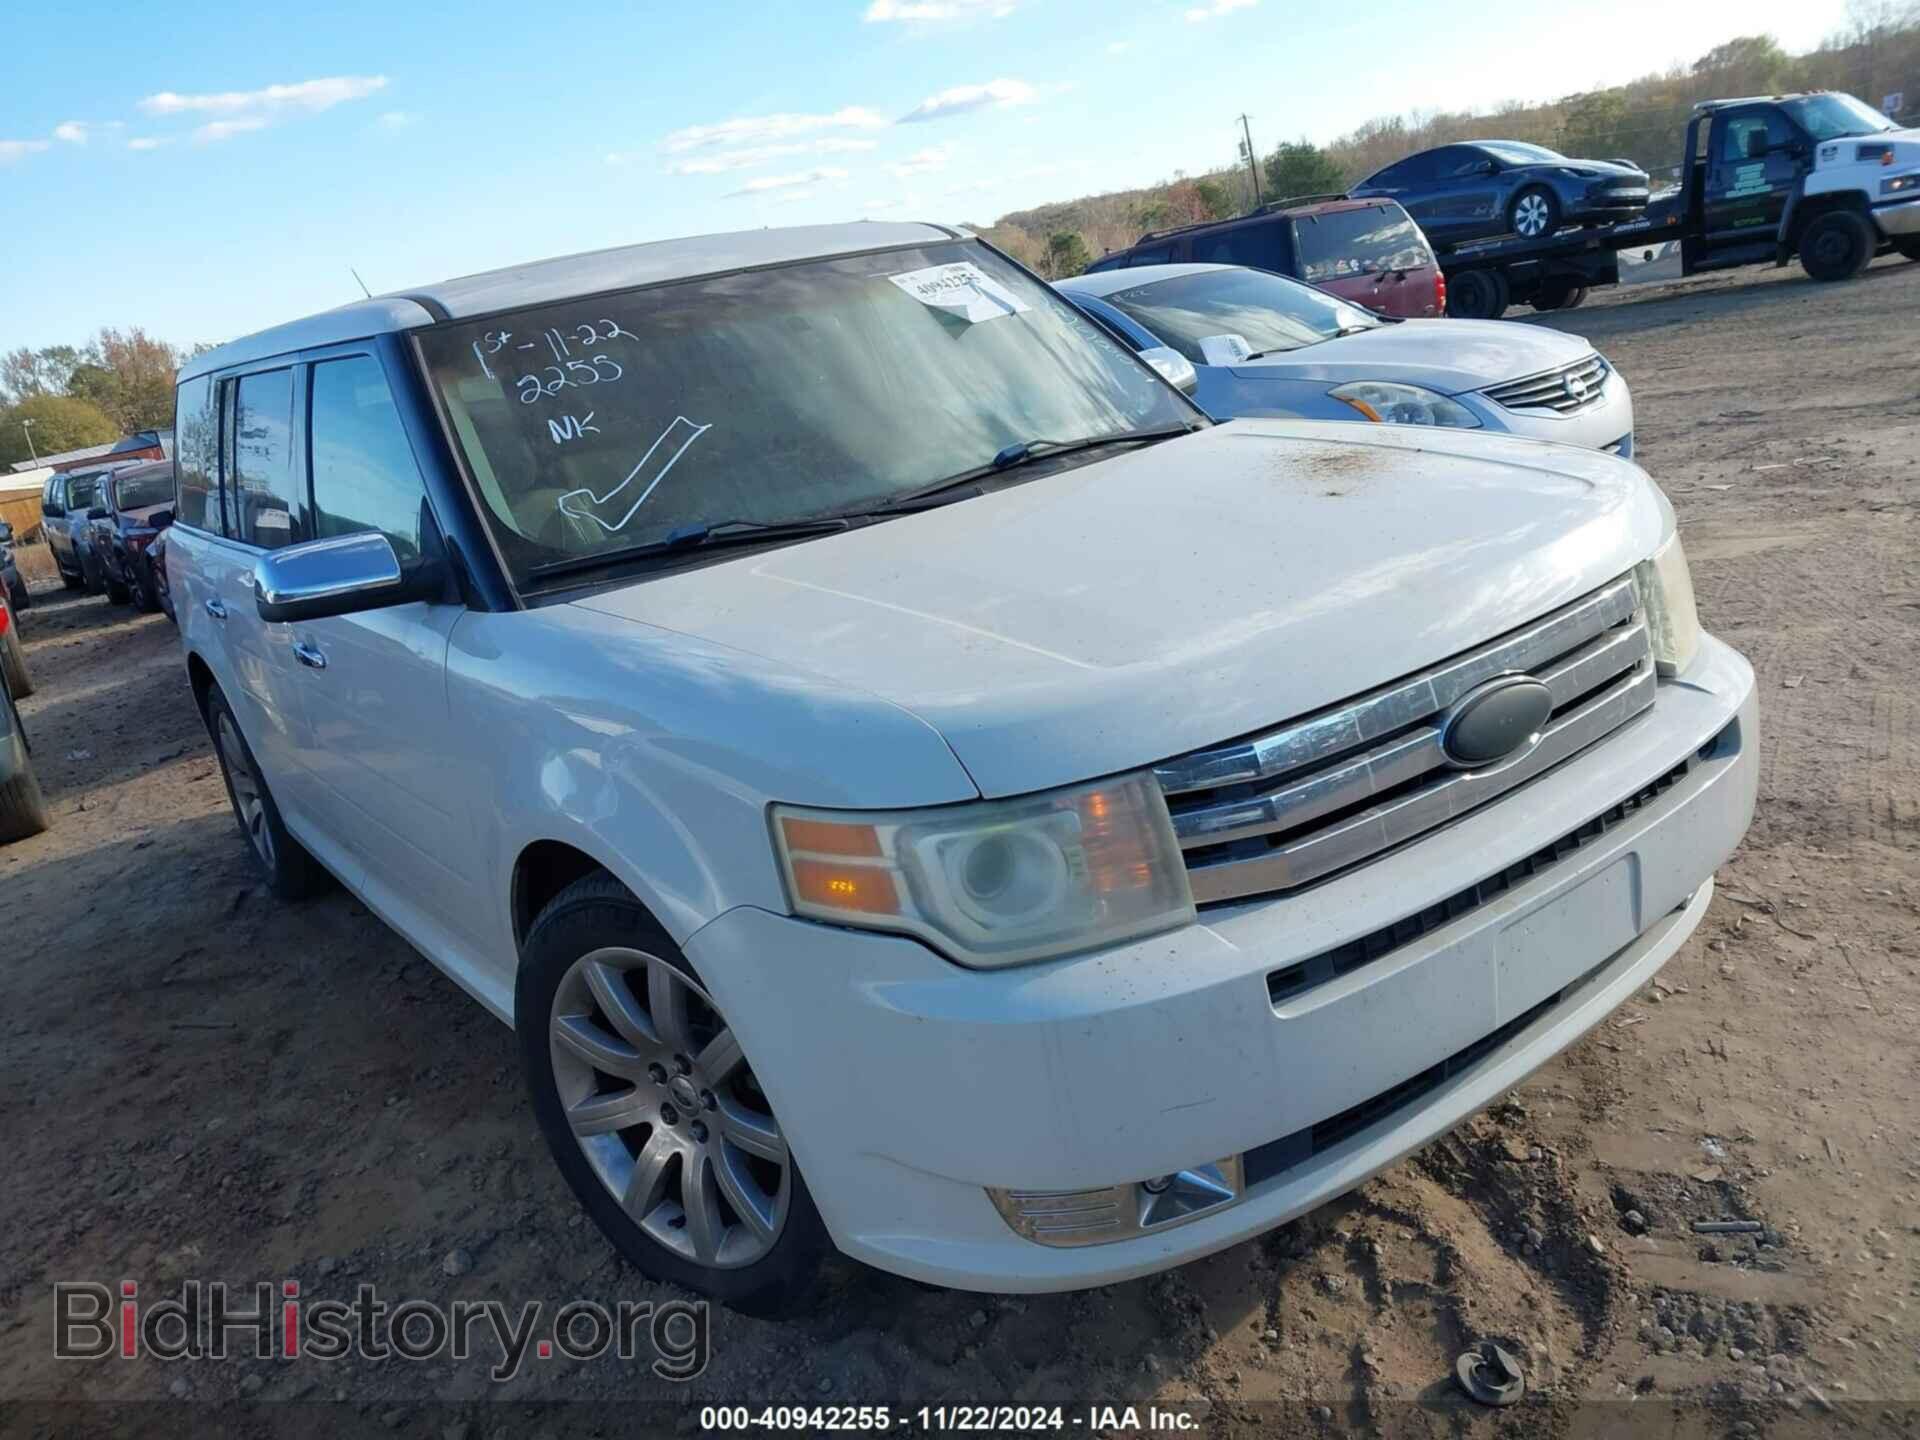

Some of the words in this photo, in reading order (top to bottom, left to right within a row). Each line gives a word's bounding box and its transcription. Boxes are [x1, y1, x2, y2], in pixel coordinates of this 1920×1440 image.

[544, 319, 640, 361] 11-22
[516, 354, 623, 404] 2255
[547, 411, 601, 444] NK
